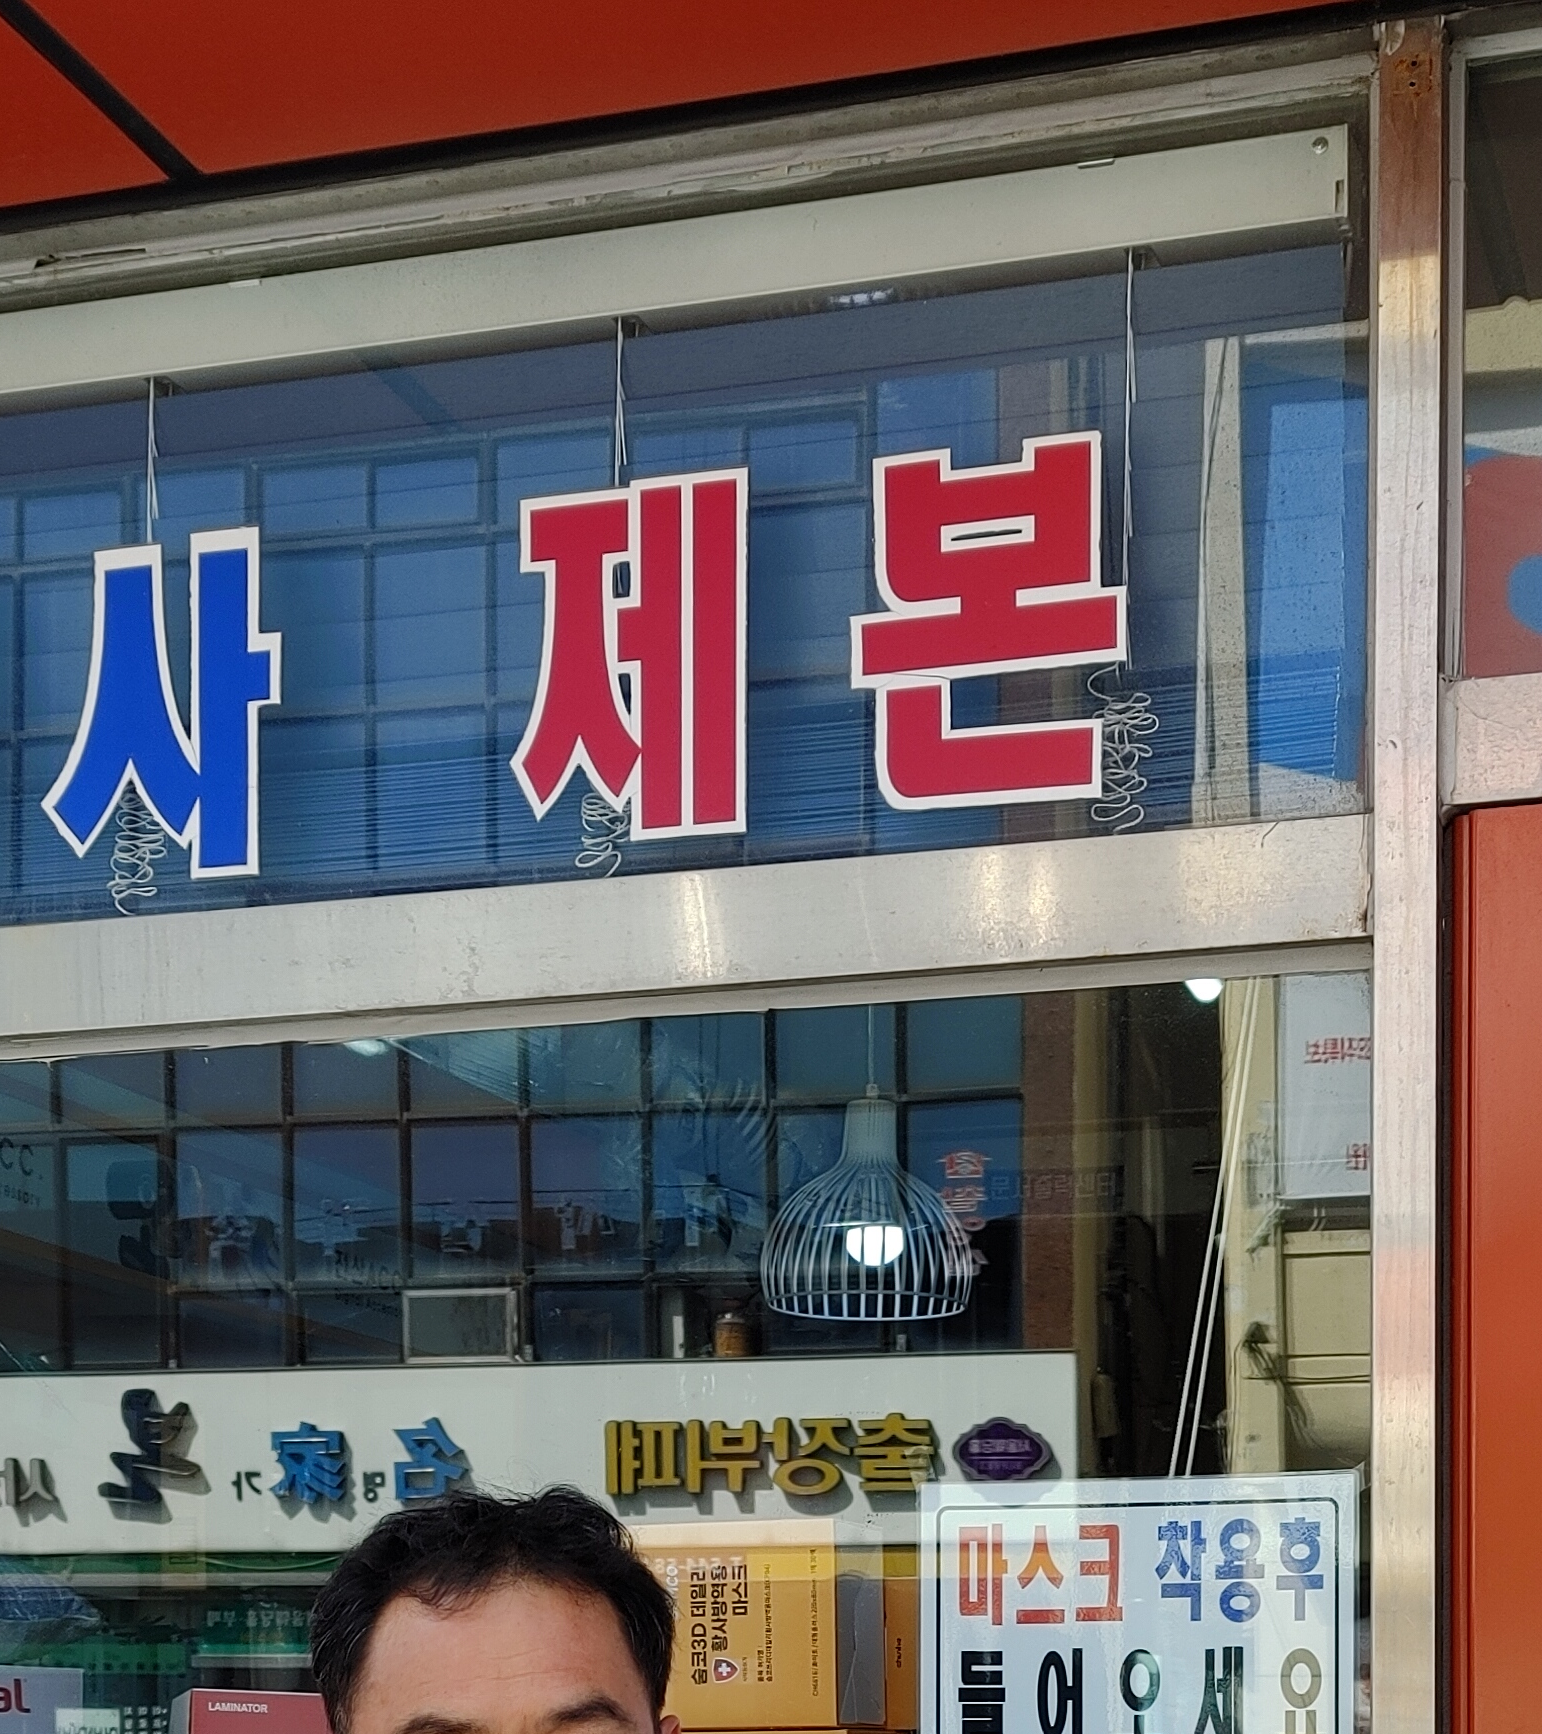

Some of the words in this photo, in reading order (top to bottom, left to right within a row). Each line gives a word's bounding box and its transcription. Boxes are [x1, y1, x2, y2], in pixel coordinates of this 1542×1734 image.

[509, 430, 1125, 840] 제본
[711, 1564, 728, 1653] 황사방역용
[732, 1564, 748, 1616] 마스크
[957, 1523, 1123, 1626] 마스크
[1155, 1517, 1324, 1623] 착용후
[691, 1623, 707, 1685] 숨코3D
[208, 1702, 268, 1715] LAMINATOR
